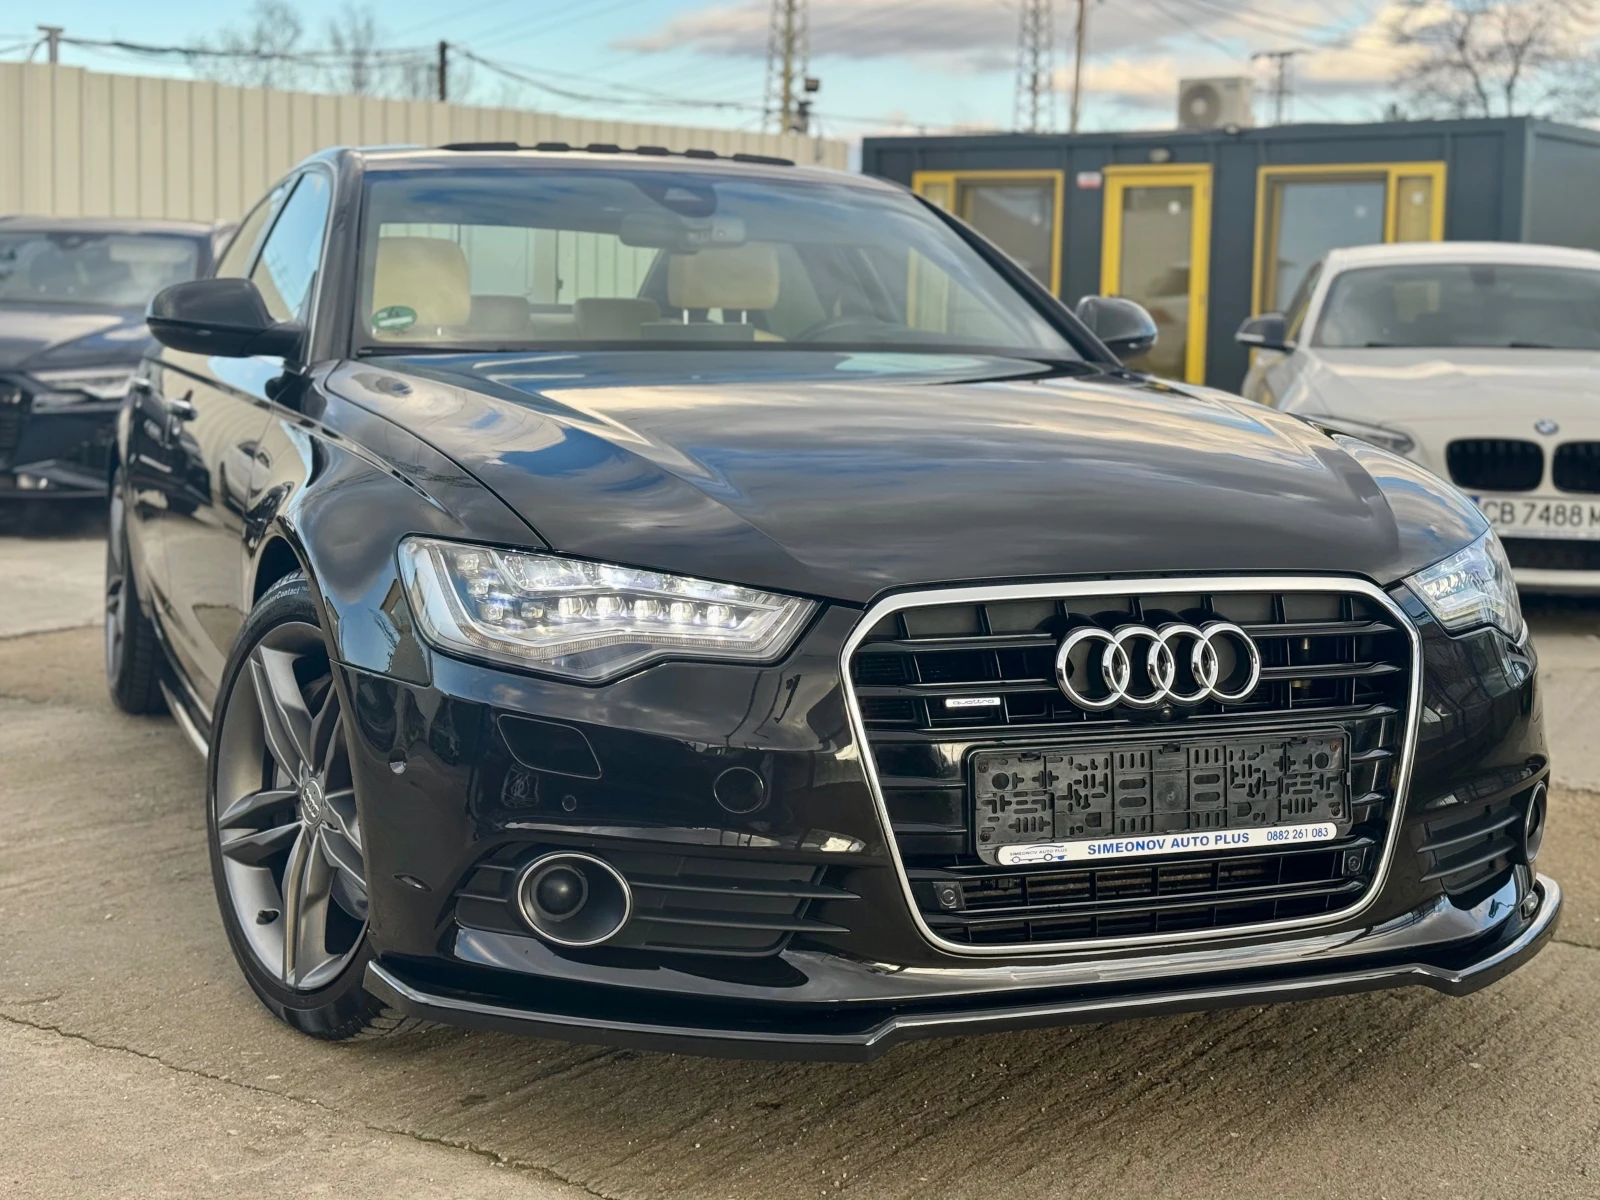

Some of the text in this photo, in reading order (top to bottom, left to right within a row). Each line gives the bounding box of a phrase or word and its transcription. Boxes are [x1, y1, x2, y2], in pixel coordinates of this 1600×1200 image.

[1483, 501, 1515, 525] CB
[1522, 502, 1582, 526] 7488
[1088, 827, 1328, 855] SIMEONOV AUTO PLUS 0882 261 083
